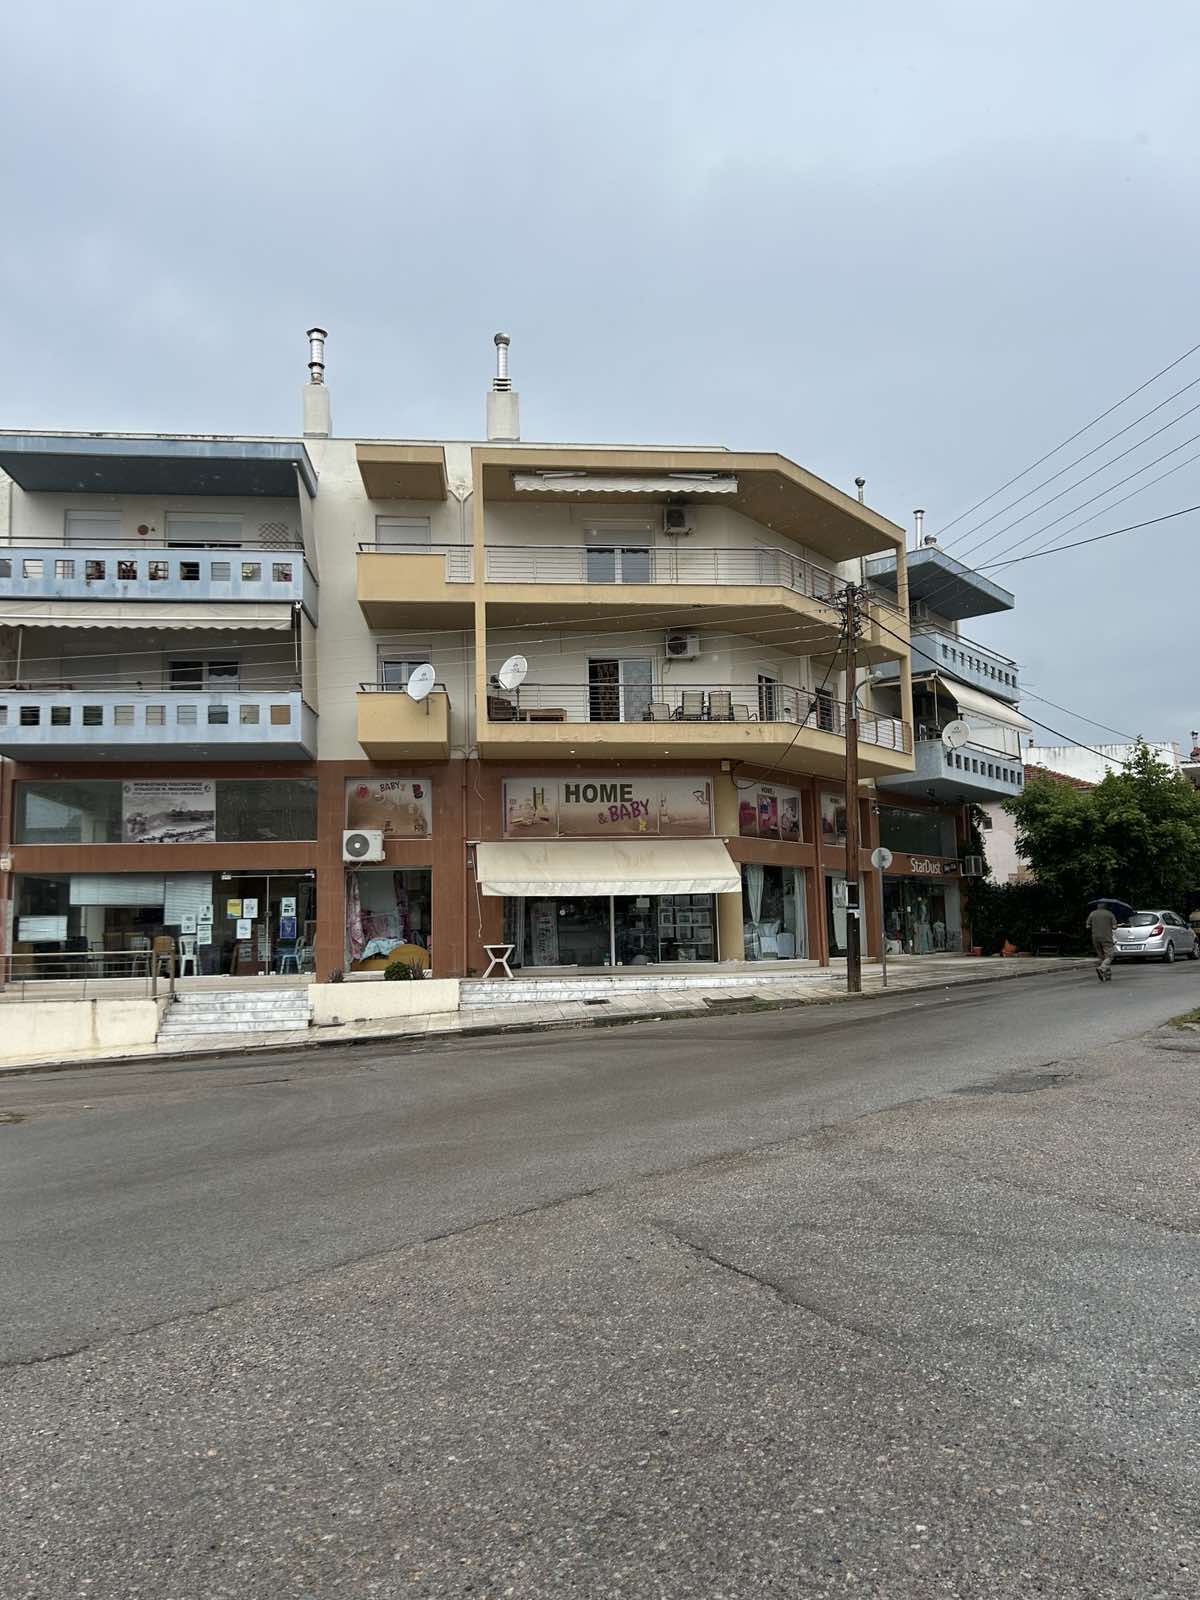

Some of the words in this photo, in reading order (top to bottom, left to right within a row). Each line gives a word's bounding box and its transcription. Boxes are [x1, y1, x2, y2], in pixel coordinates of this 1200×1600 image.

[379, 780, 401, 792] BABY
[565, 783, 633, 804] HOME
[597, 812, 608, 825] &
[608, 799, 650, 822] BABY
[911, 857, 942, 874] StarDust
